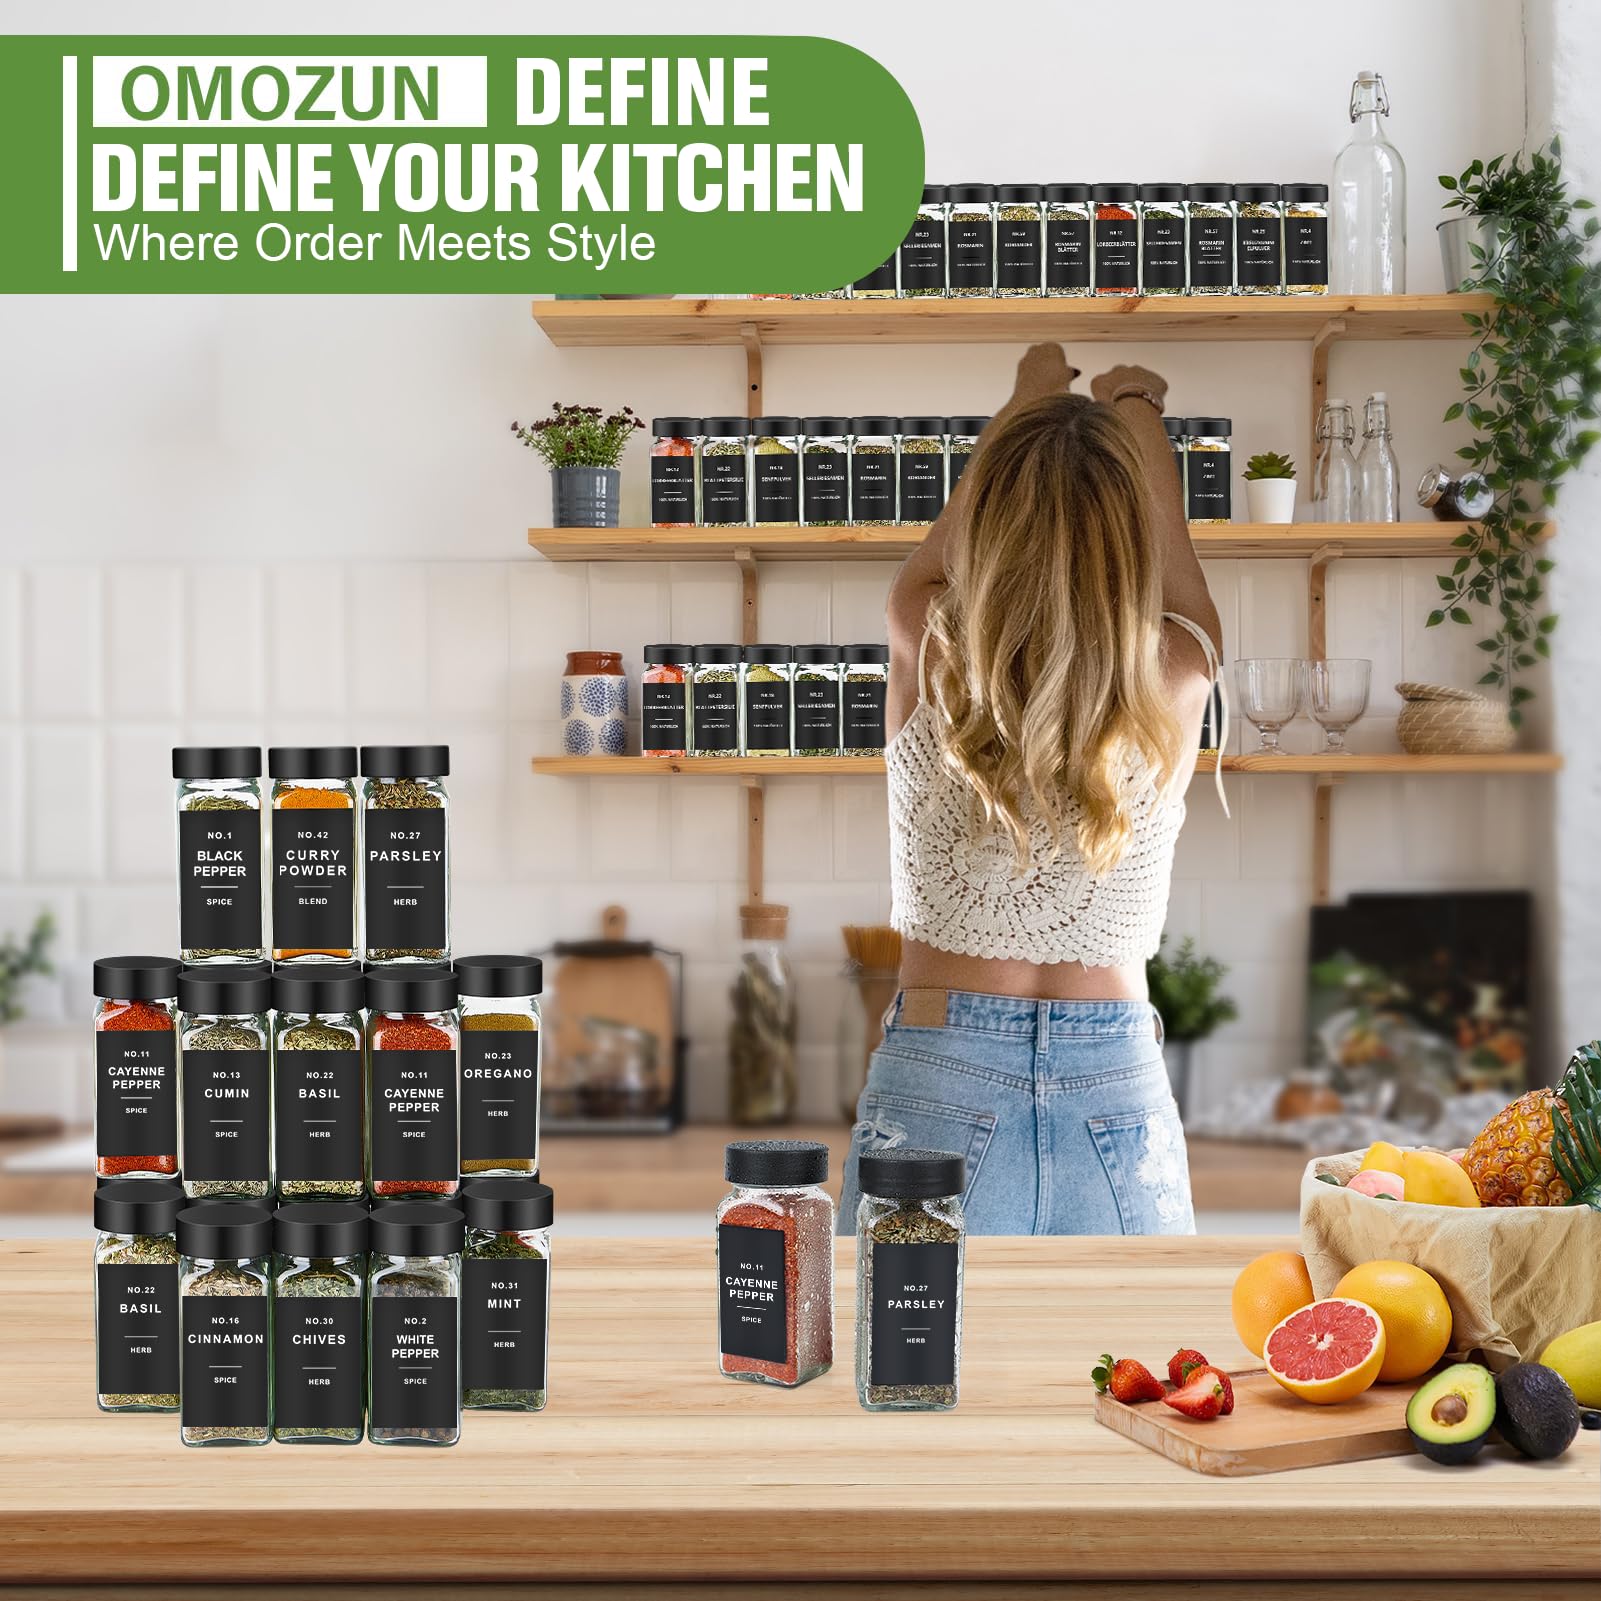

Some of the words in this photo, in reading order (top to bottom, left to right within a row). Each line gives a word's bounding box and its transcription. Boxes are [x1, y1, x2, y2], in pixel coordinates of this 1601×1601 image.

[198, 851, 243, 861] BLACK
[286, 850, 339, 860] CURRY
[370, 851, 441, 861] PARSLEY
[194, 866, 246, 876] PEPPER
[280, 865, 347, 876] POWDER
[108, 1067, 165, 1076] CAYENNE
[464, 1069, 532, 1078] OREGANO
[113, 1080, 160, 1089] PEPPER
[205, 1089, 249, 1098] CUMIN
[299, 1089, 340, 1098] BASIL
[385, 1089, 444, 1098] CAYENNE
[389, 1103, 439, 1112] PEPPER
[725, 1276, 779, 1290] CAYENNE
[729, 1289, 774, 1303] PEPPER
[488, 1299, 521, 1308] MINT
[888, 1300, 944, 1308] PARSLEY
[120, 1304, 161, 1313] BASIL
[188, 1334, 263, 1343] CINNAMON
[293, 1335, 345, 1344] CHIVES
[396, 1335, 434, 1344] WHITE
[392, 1349, 439, 1358] PEPPER
